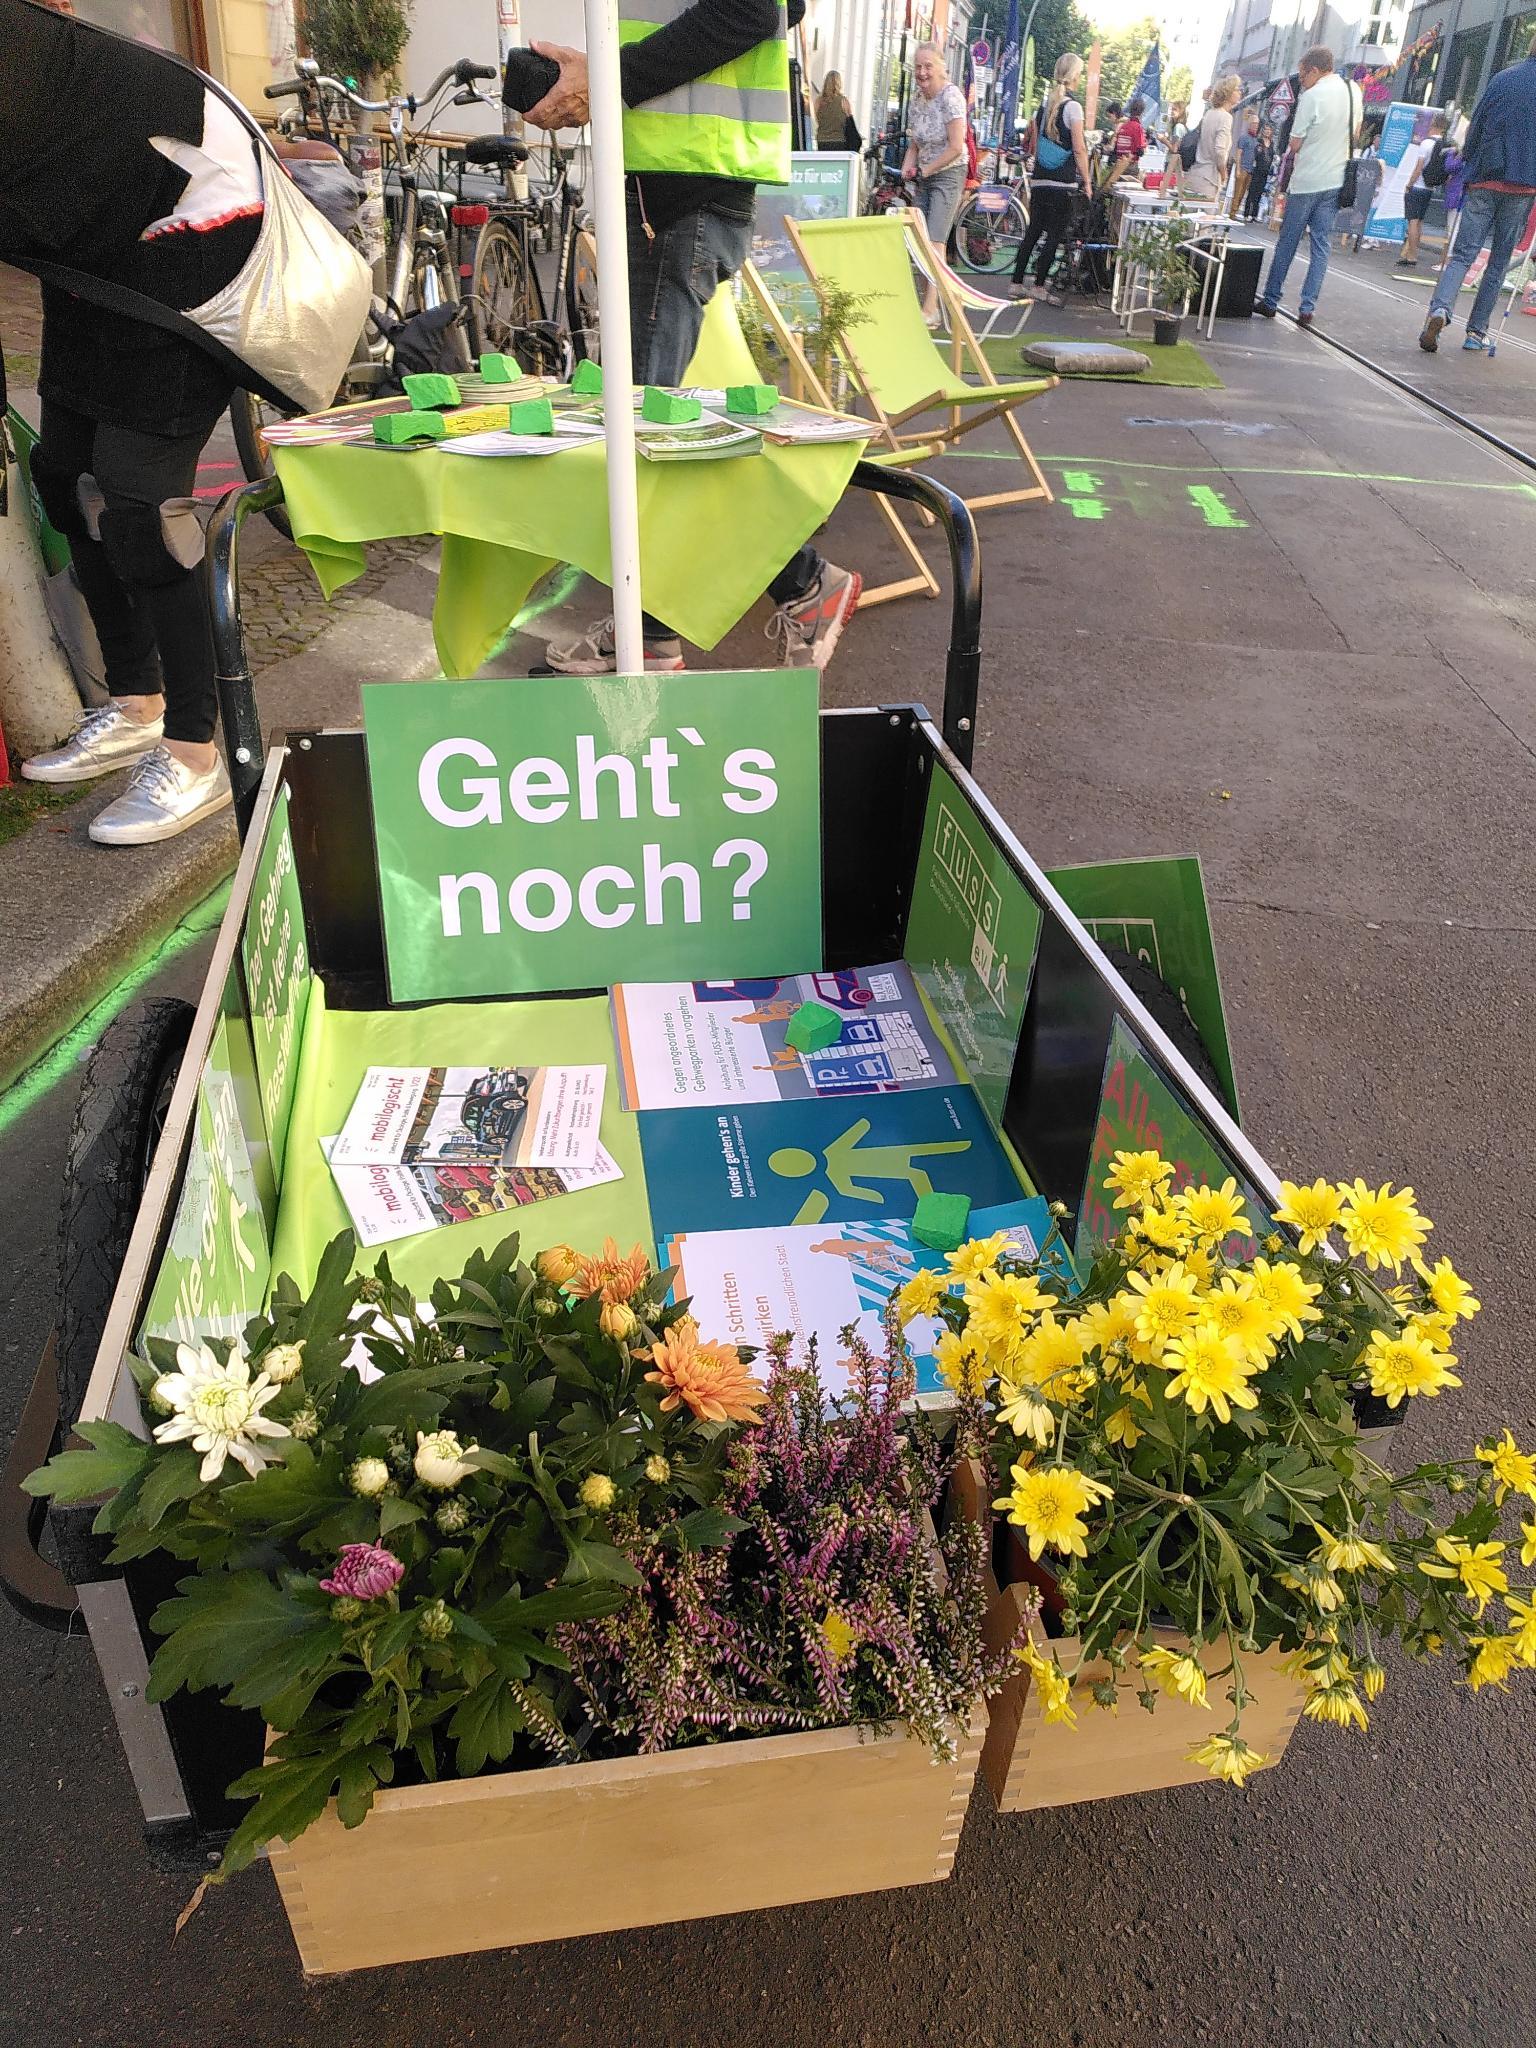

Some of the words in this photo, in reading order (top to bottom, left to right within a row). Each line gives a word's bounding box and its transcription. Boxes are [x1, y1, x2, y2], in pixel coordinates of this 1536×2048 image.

[438, 838, 770, 938] noch?
[248, 932, 264, 1011] Der
[259, 826, 293, 948] Gehweg
[262, 990, 279, 1044] ist
[271, 907, 292, 991] keine
[677, 996, 693, 1031] vorgehen
[663, 1012, 681, 1065] angeordnetes
[683, 1034, 706, 1092] Gehwegparken
[717, 1056, 725, 1064] für
[674, 1067, 687, 1093] Gegen
[736, 1079, 746, 1090] und
[370, 1077, 404, 1141] mobilogisch!
[717, 1117, 728, 1128] an
[719, 1130, 740, 1164] gehen's
[363, 1164, 402, 1212] mobilogi
[726, 1166, 744, 1198] Kinder
[749, 1188, 757, 1197] Den
[172, 1258, 204, 1342] lle
[201, 1080, 234, 1279] gehen
[776, 1244, 789, 1266] Stadt
[1022, 1244, 1033, 1260] USS
[722, 1272, 745, 1332] Schritten
